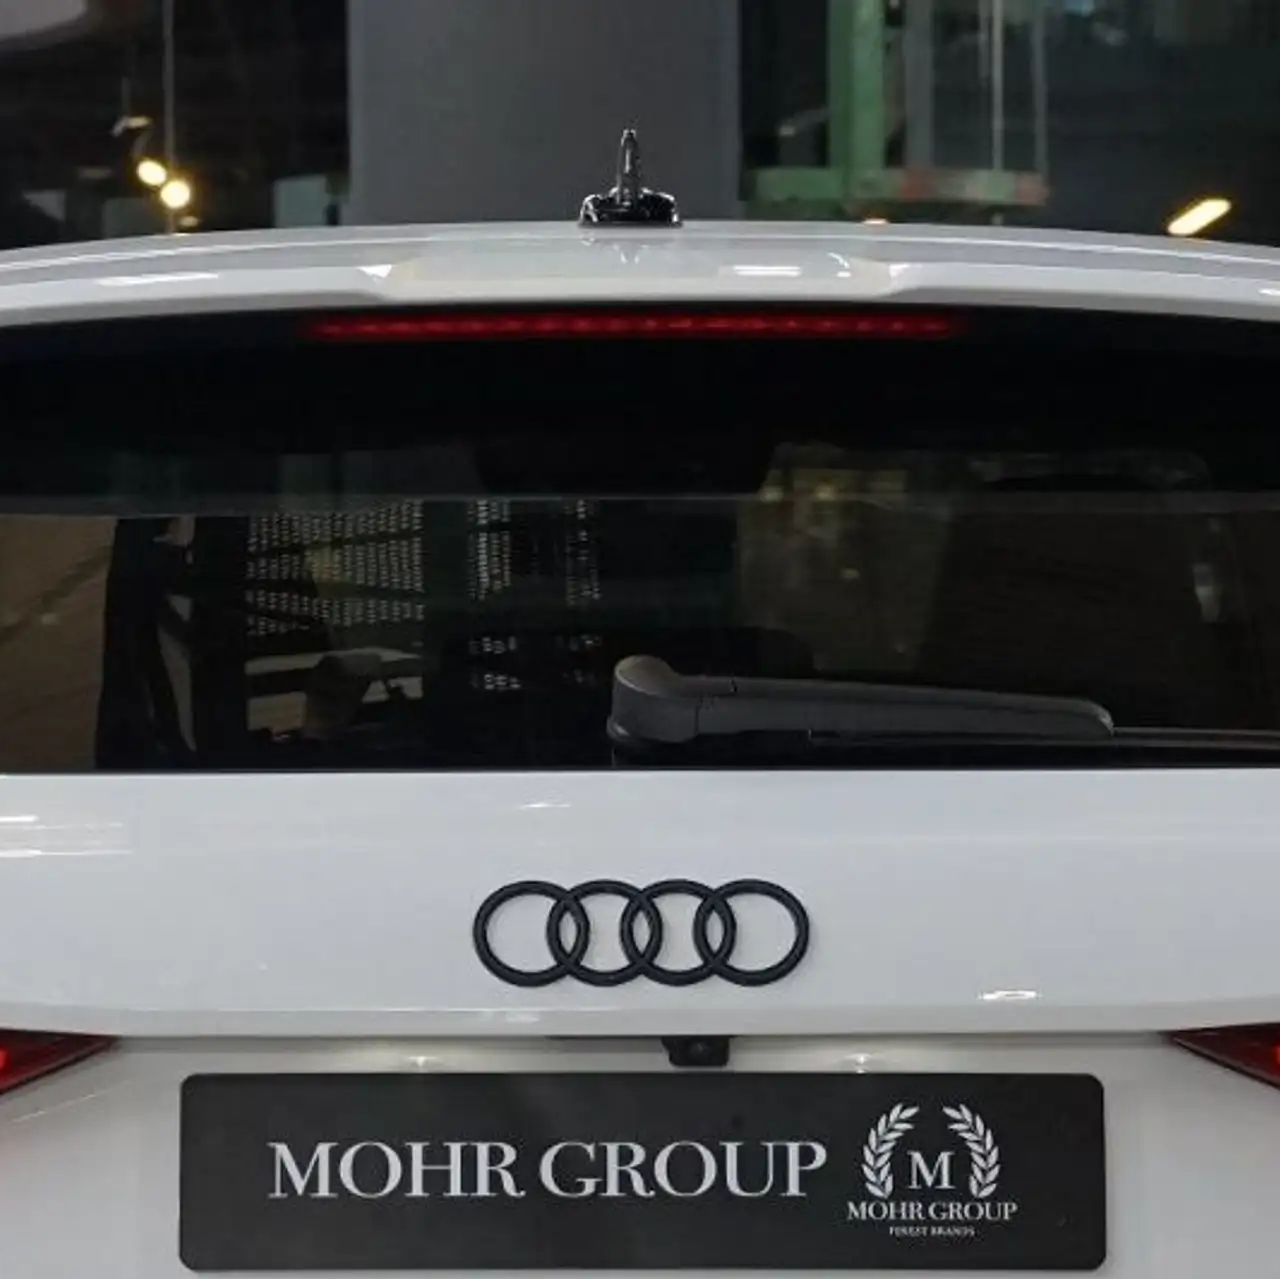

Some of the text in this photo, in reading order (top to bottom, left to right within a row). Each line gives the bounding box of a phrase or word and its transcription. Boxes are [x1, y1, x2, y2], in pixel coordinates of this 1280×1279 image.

[268, 1140, 828, 1199] MOHR GROUP
[907, 1151, 956, 1190] M
[847, 1201, 1019, 1221] MOHR GROUP
